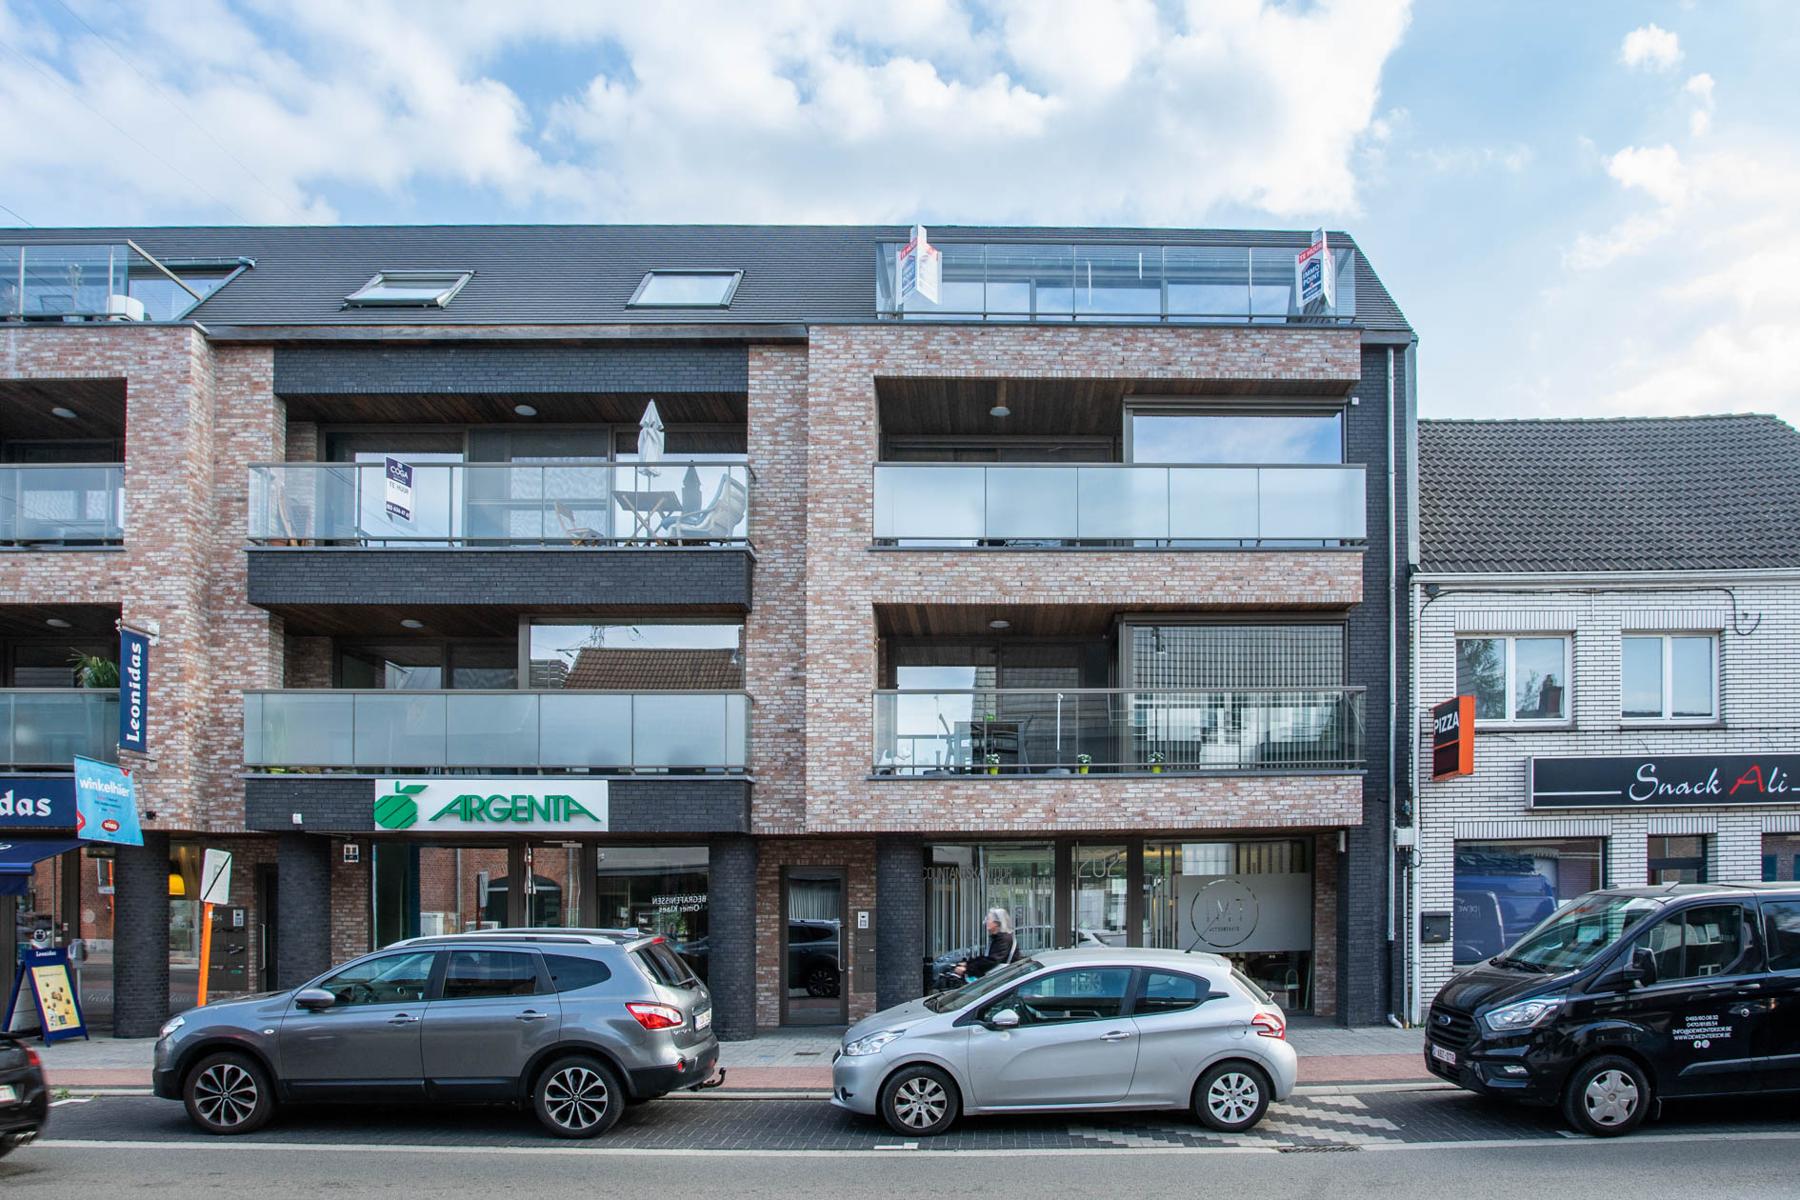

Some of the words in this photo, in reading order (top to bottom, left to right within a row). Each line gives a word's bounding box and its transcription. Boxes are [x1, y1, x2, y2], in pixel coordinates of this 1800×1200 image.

[1303, 264, 1320, 279] IMMO
[1303, 270, 1320, 287] POINT
[390, 465, 409, 479] COGA
[126, 642, 142, 743] Leonidas
[1433, 711, 1460, 735] PIZZA
[80, 777, 130, 797] winkelhier
[1628, 763, 1722, 801] Snack
[1729, 764, 1788, 795] Ali
[0, 790, 52, 817] das
[428, 794, 602, 822] ARGENTA
[1079, 849, 1120, 878] 202
